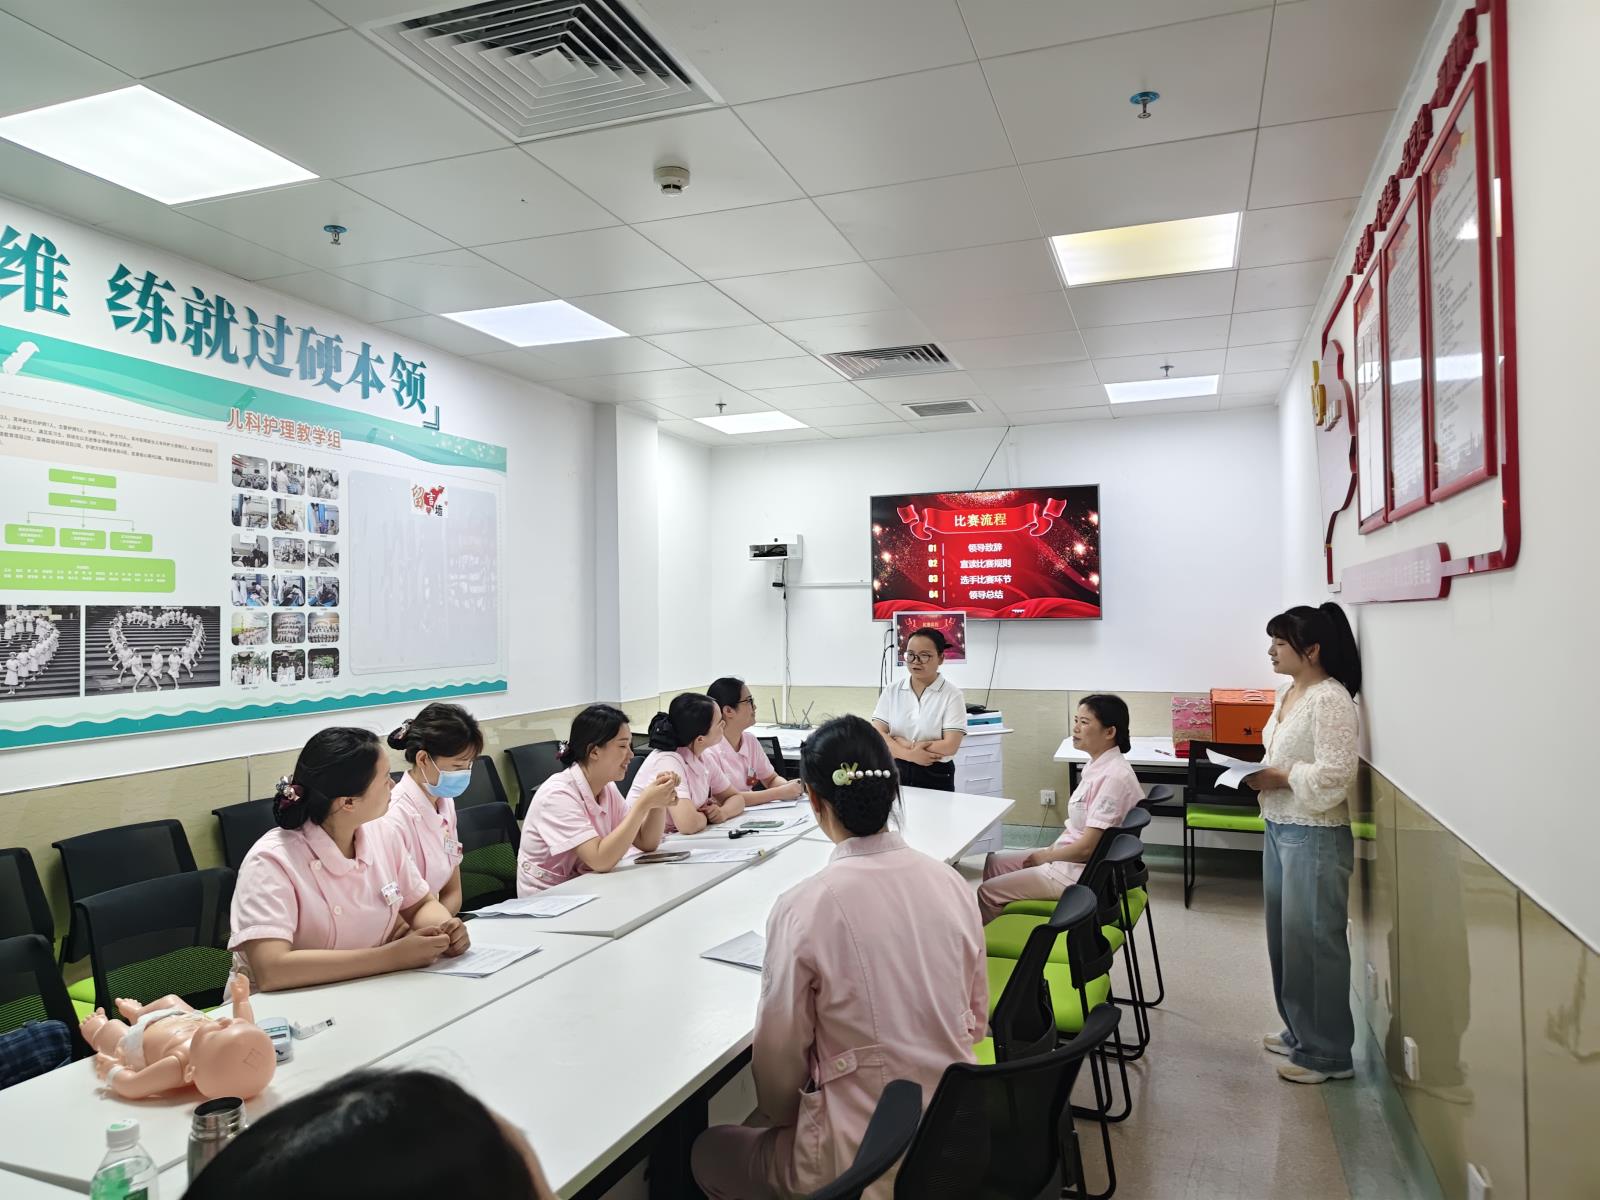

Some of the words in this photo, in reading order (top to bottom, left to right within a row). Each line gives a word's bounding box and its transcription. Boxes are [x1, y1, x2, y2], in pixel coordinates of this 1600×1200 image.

[0, 224, 71, 317] 维
[227, 407, 342, 449] 儿科护理教学组
[954, 513, 1006, 527] 比赛流程
[968, 543, 1002, 552] 领导致辞
[960, 575, 1012, 584] 选手比赛环节
[969, 590, 1003, 599] 领导总结
